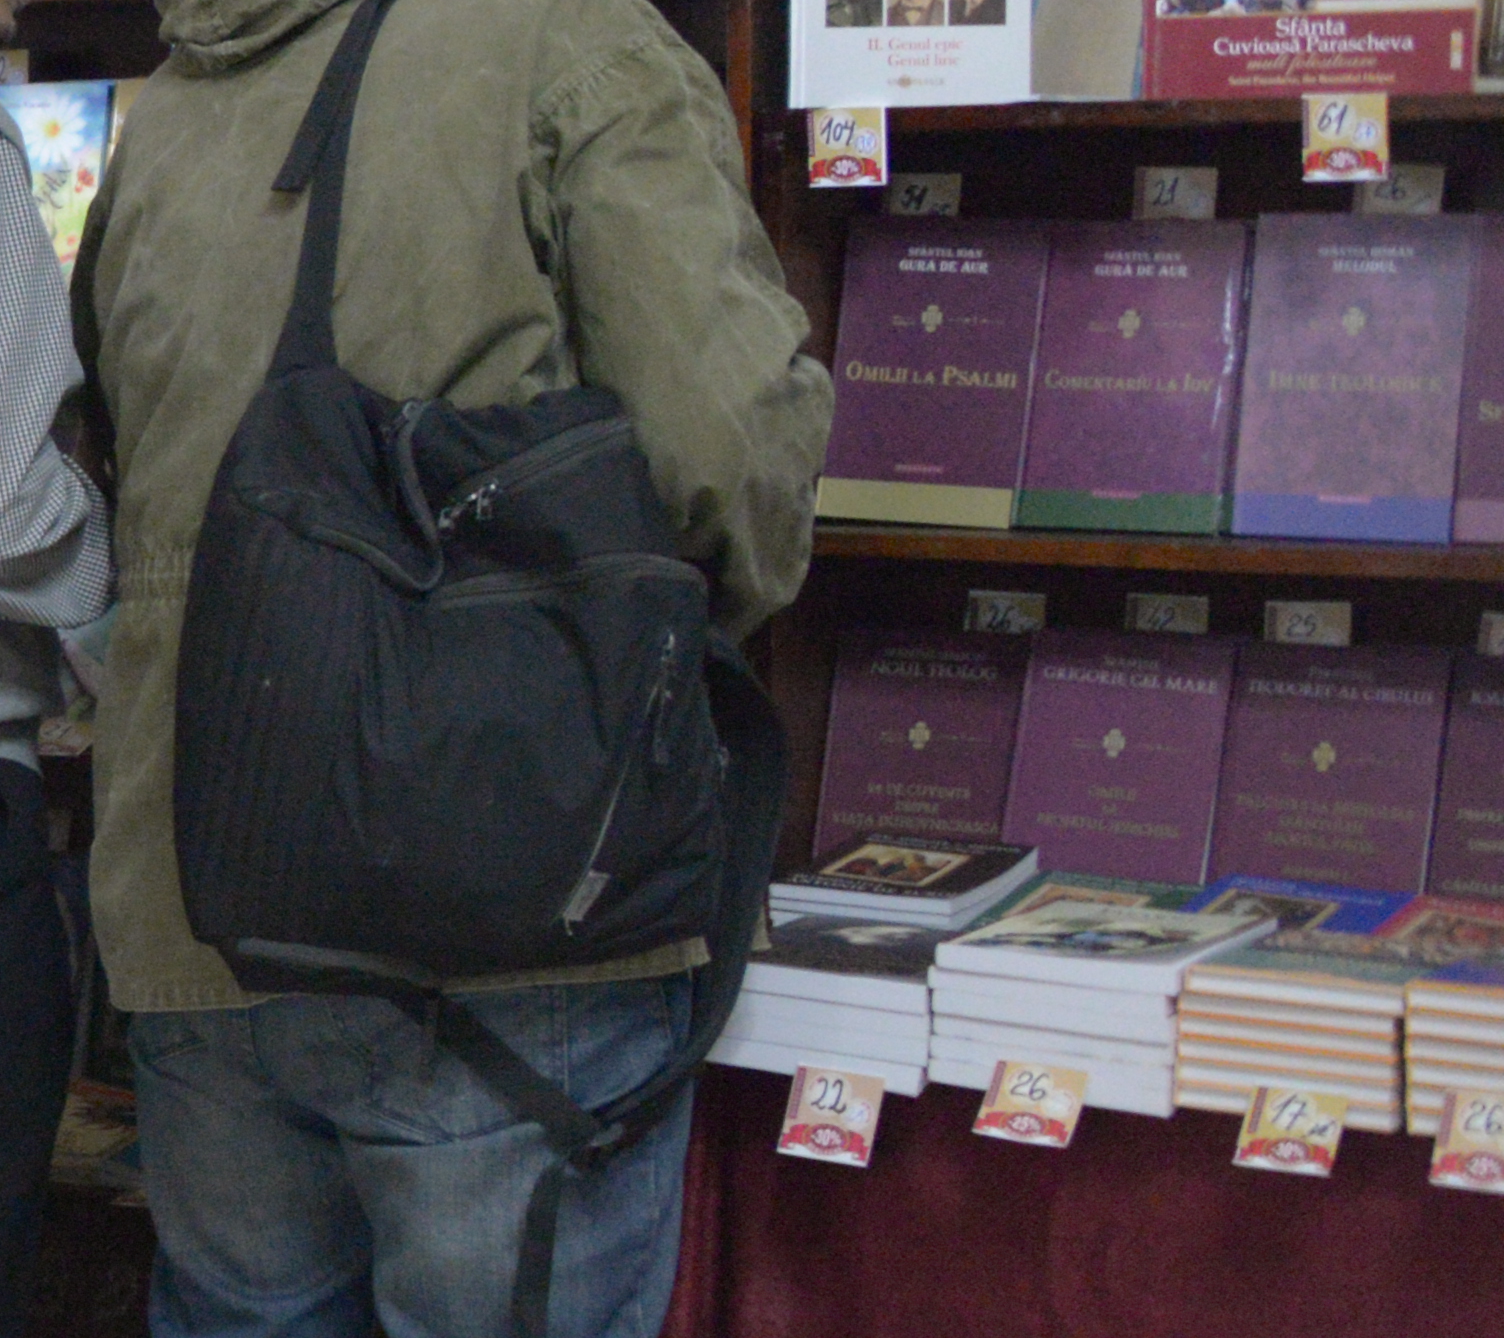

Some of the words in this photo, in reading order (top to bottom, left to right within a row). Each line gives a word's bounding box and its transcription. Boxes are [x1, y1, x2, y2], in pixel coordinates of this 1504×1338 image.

[1275, 16, 1346, 39] Sfânta
[1305, 33, 1415, 54] Parascheva
[819, 117, 857, 147] 104
[1317, 101, 1348, 135] 61
[942, 364, 1018, 389] PSALMI
[810, 1077, 847, 1115] 22
[1009, 1071, 1047, 1103] 26
[1464, 1099, 1501, 1133] 26
